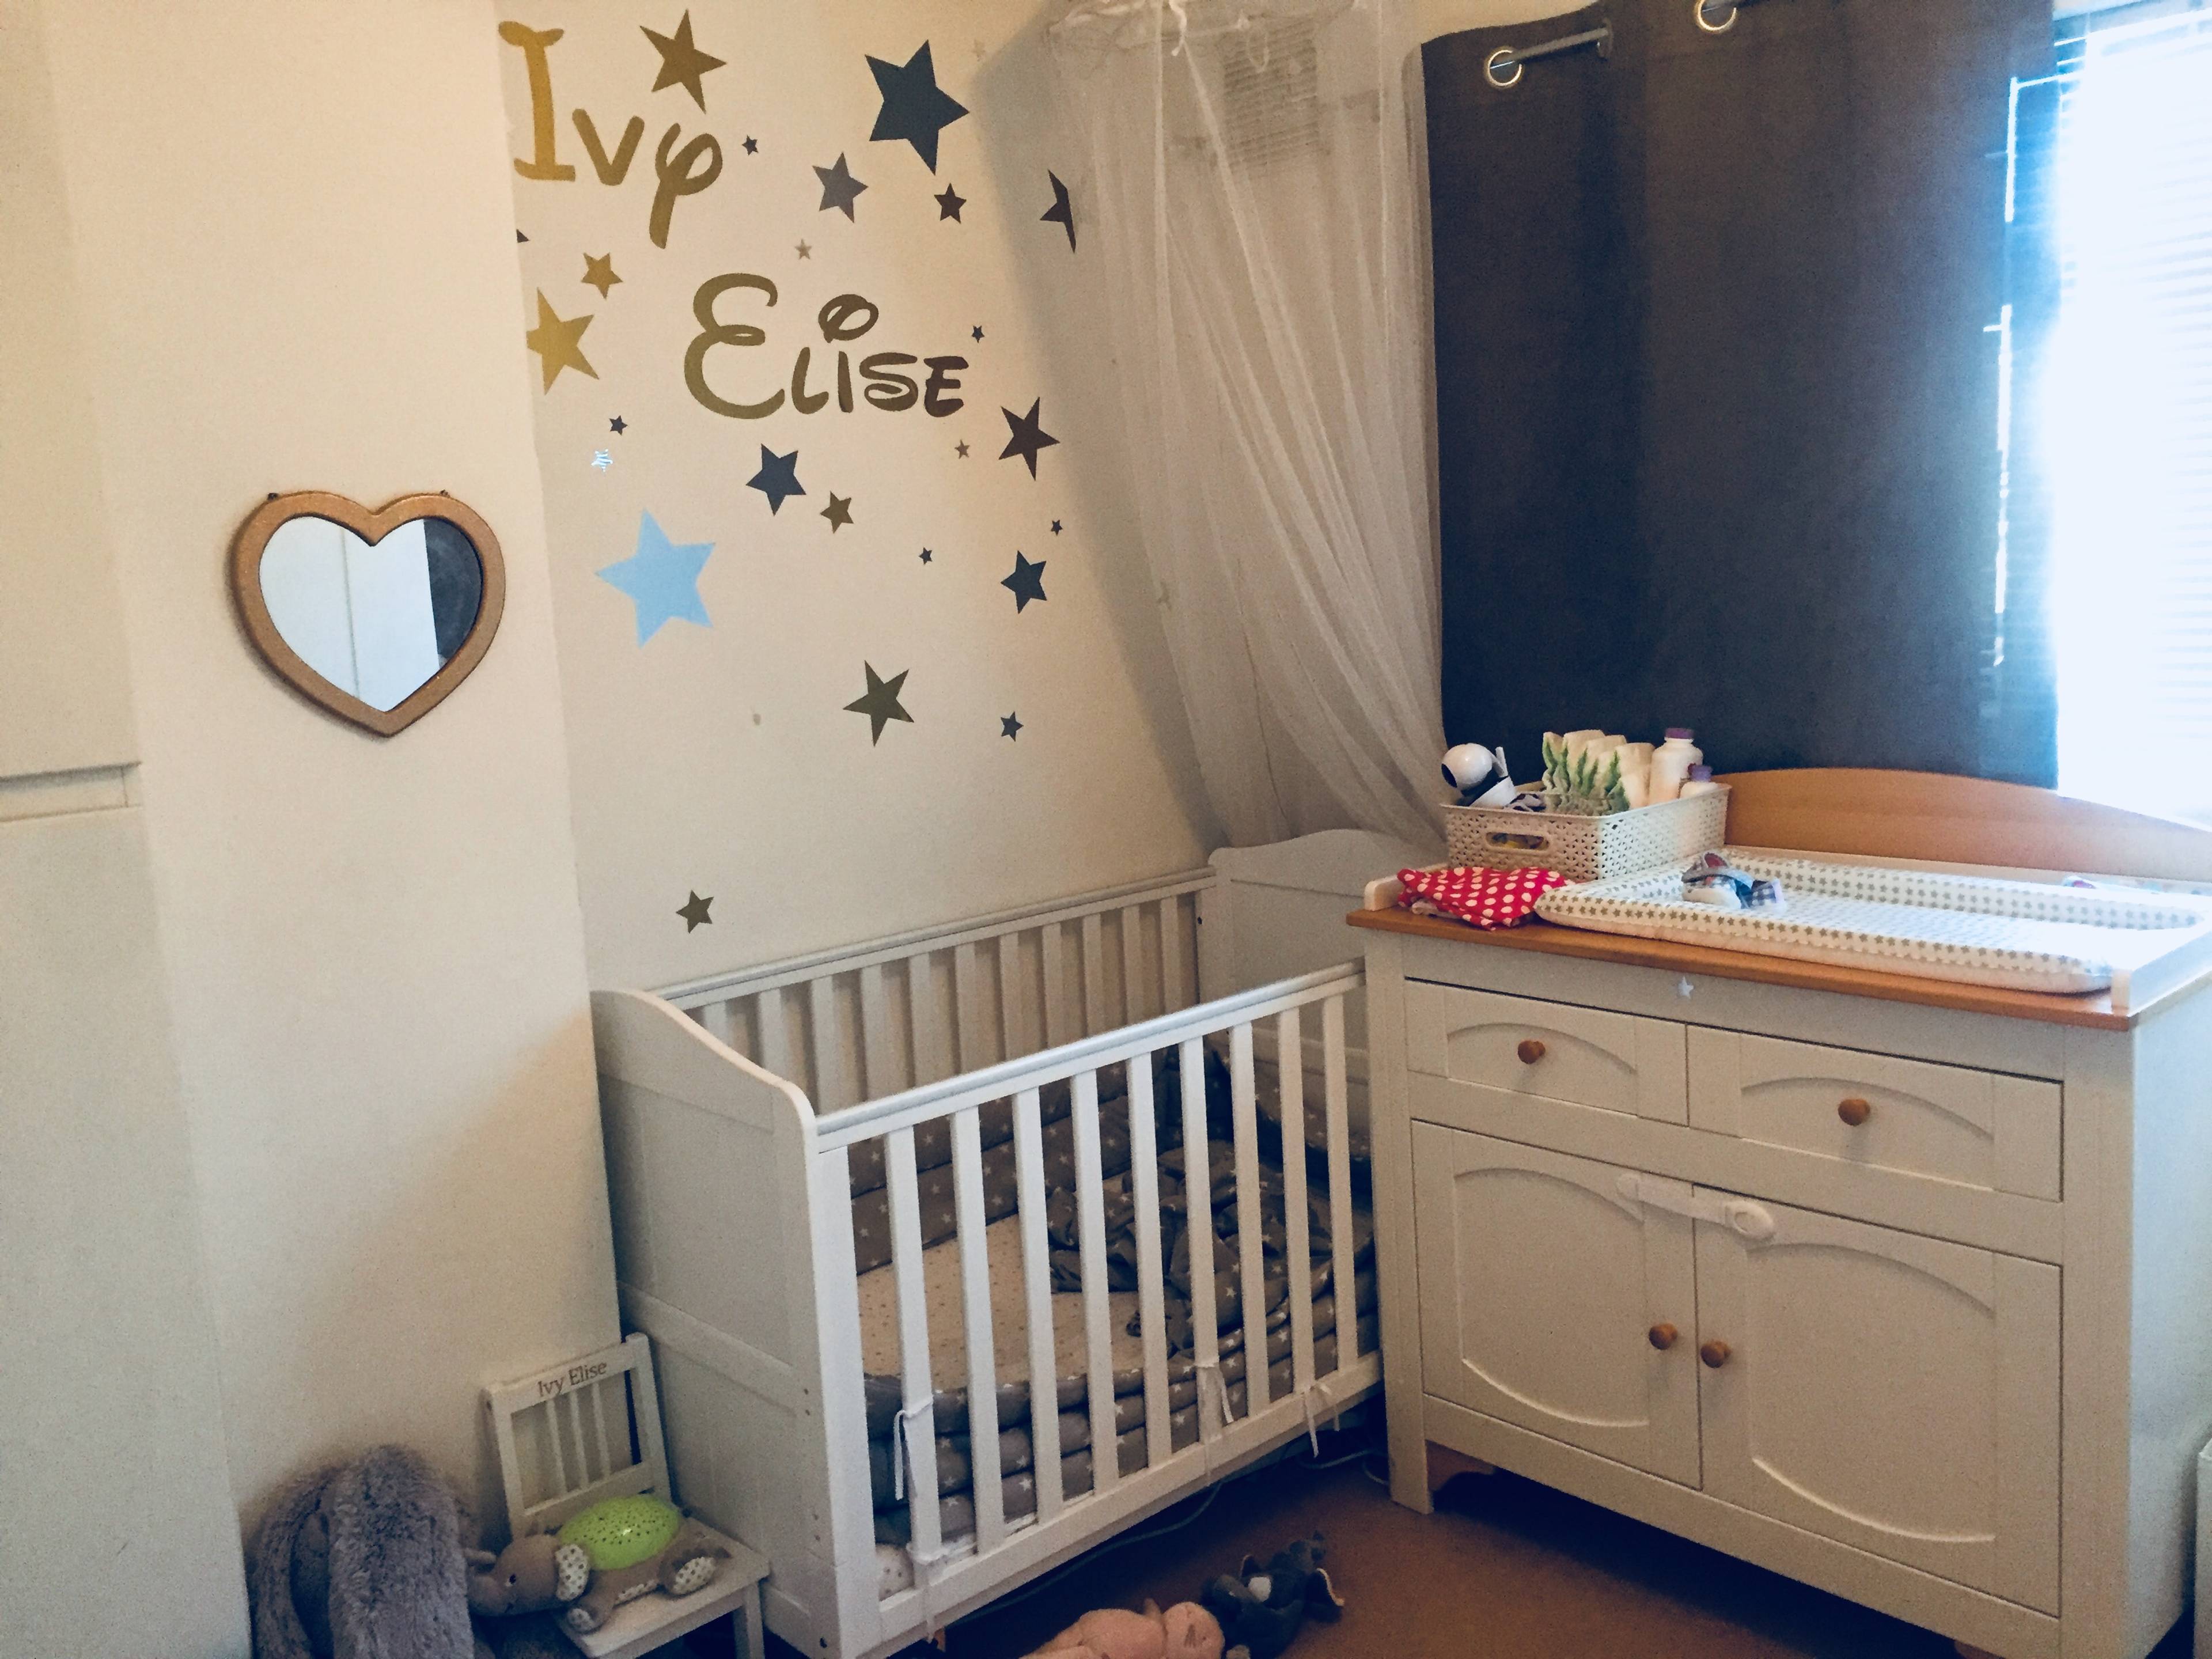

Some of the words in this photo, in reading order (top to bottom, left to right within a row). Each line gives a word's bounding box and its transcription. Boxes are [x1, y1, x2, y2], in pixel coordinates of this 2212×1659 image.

[498, 21, 724, 249] Ivy
[537, 1377, 564, 1397] Ivy
[568, 1363, 607, 1385] Elise
